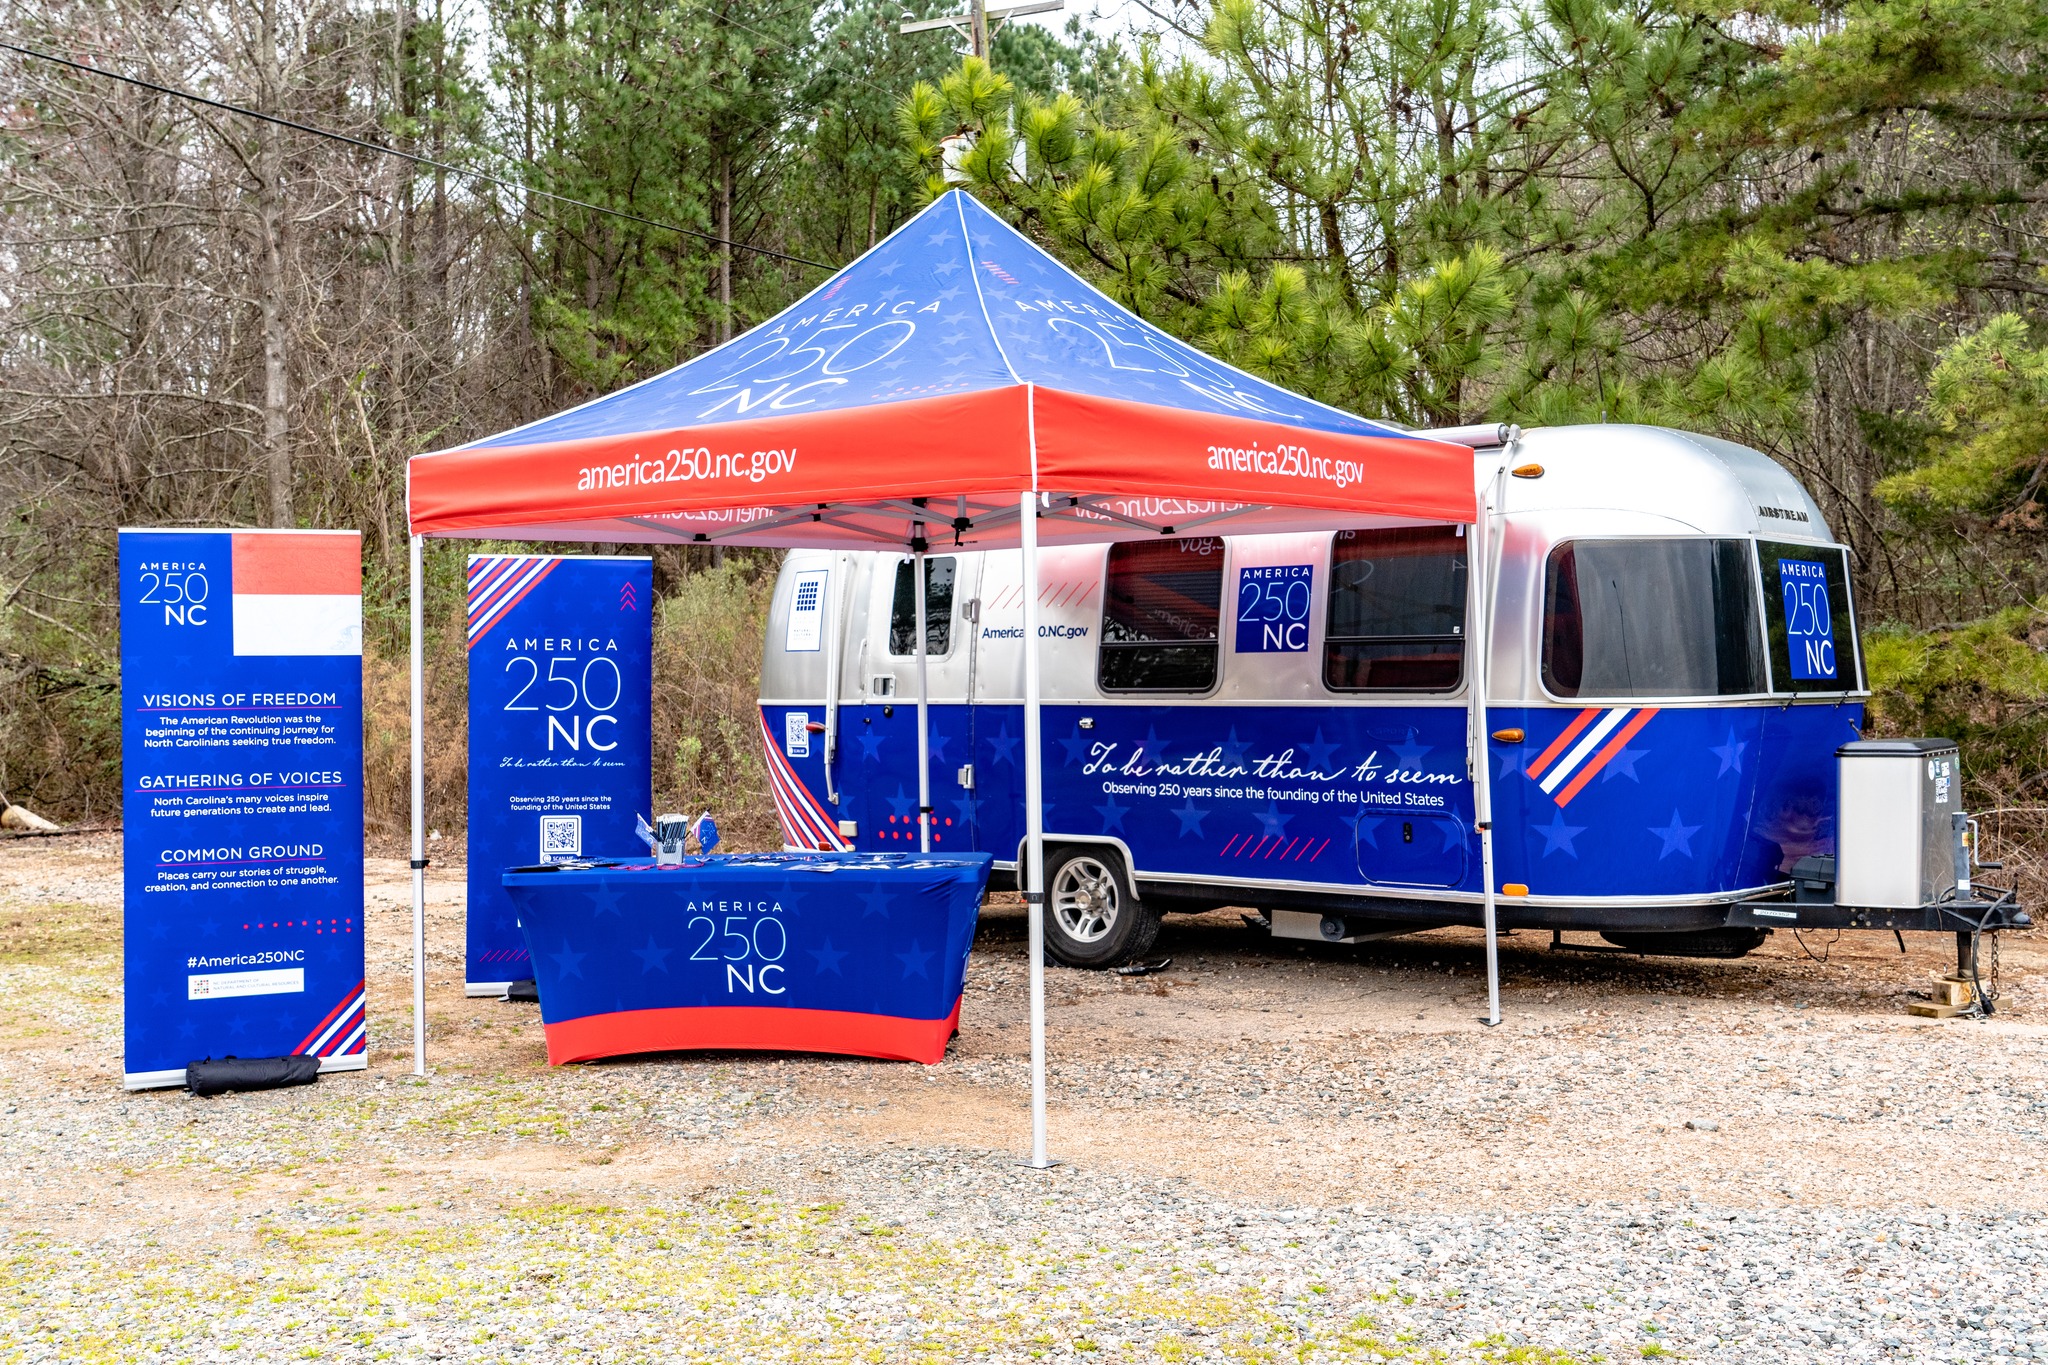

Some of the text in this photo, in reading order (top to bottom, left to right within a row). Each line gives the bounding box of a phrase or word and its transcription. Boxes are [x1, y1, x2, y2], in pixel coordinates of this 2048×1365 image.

[764, 301, 940, 338] AMERICA
[1015, 300, 1156, 337] AMERICA
[687, 320, 916, 396] 250
[1048, 318, 1235, 388] 250
[696, 378, 849, 418] NC
[1179, 379, 1304, 419] NC
[578, 447, 796, 491] america250.nc.gov
[1208, 442, 1363, 488] america250.nc.gov
[1759, 506, 1808, 522] AIRSTREAM
[1243, 568, 1309, 578] AMERICA
[1782, 563, 1824, 577] AMERICA
[140, 573, 208, 603] 250
[1239, 581, 1309, 621] 250
[1785, 582, 1830, 636] 250
[165, 605, 207, 625] NC
[982, 625, 1088, 639] America0.NC.gov
[1263, 623, 1307, 650] NC
[506, 638, 617, 651] AMERICA
[1806, 640, 1834, 675] NC
[504, 657, 620, 711] 250
[143, 693, 335, 707] VISIONS OF FREEDOM
[146, 725, 334, 737] beginning of the continuing journey for
[160, 717, 178, 725] The
[181, 716, 228, 724] American
[231, 716, 281, 724] Revolution
[145, 739, 173, 747] North
[176, 738, 229, 747] Carolinians
[233, 737, 268, 746] seeking
[294, 736, 336, 744] freedom.
[549, 715, 617, 751] NC
[500, 757, 513, 767] To
[514, 758, 526, 767] be
[527, 757, 559, 767] rather
[560, 757, 591, 767] than
[592, 757, 601, 766] to
[1083, 742, 1463, 785] To be rather than to seem
[140, 771, 341, 788] GATHERING OF VOICES
[155, 797, 183, 805] North
[186, 796, 233, 805] Carolina's
[265, 794, 294, 802] voices
[298, 793, 328, 802] inspire
[1103, 782, 1444, 806] Observing 250 years since the founding of the United States
[151, 809, 181, 817] future
[184, 807, 241, 817] generations
[289, 804, 306, 812] and
[161, 844, 322, 862] COMMON GROUND
[158, 872, 189, 880] Places
[239, 868, 270, 877] stories
[273, 867, 283, 875] of
[286, 865, 326, 875] struggle,
[145, 883, 188, 892] creation,
[191, 881, 209, 890] and
[212, 880, 265, 889] connection
[301, 876, 338, 884] another.
[687, 902, 782, 912] AMERICA
[688, 917, 786, 961] 250
[187, 950, 304, 968] #America250NC
[727, 964, 785, 994] NC
